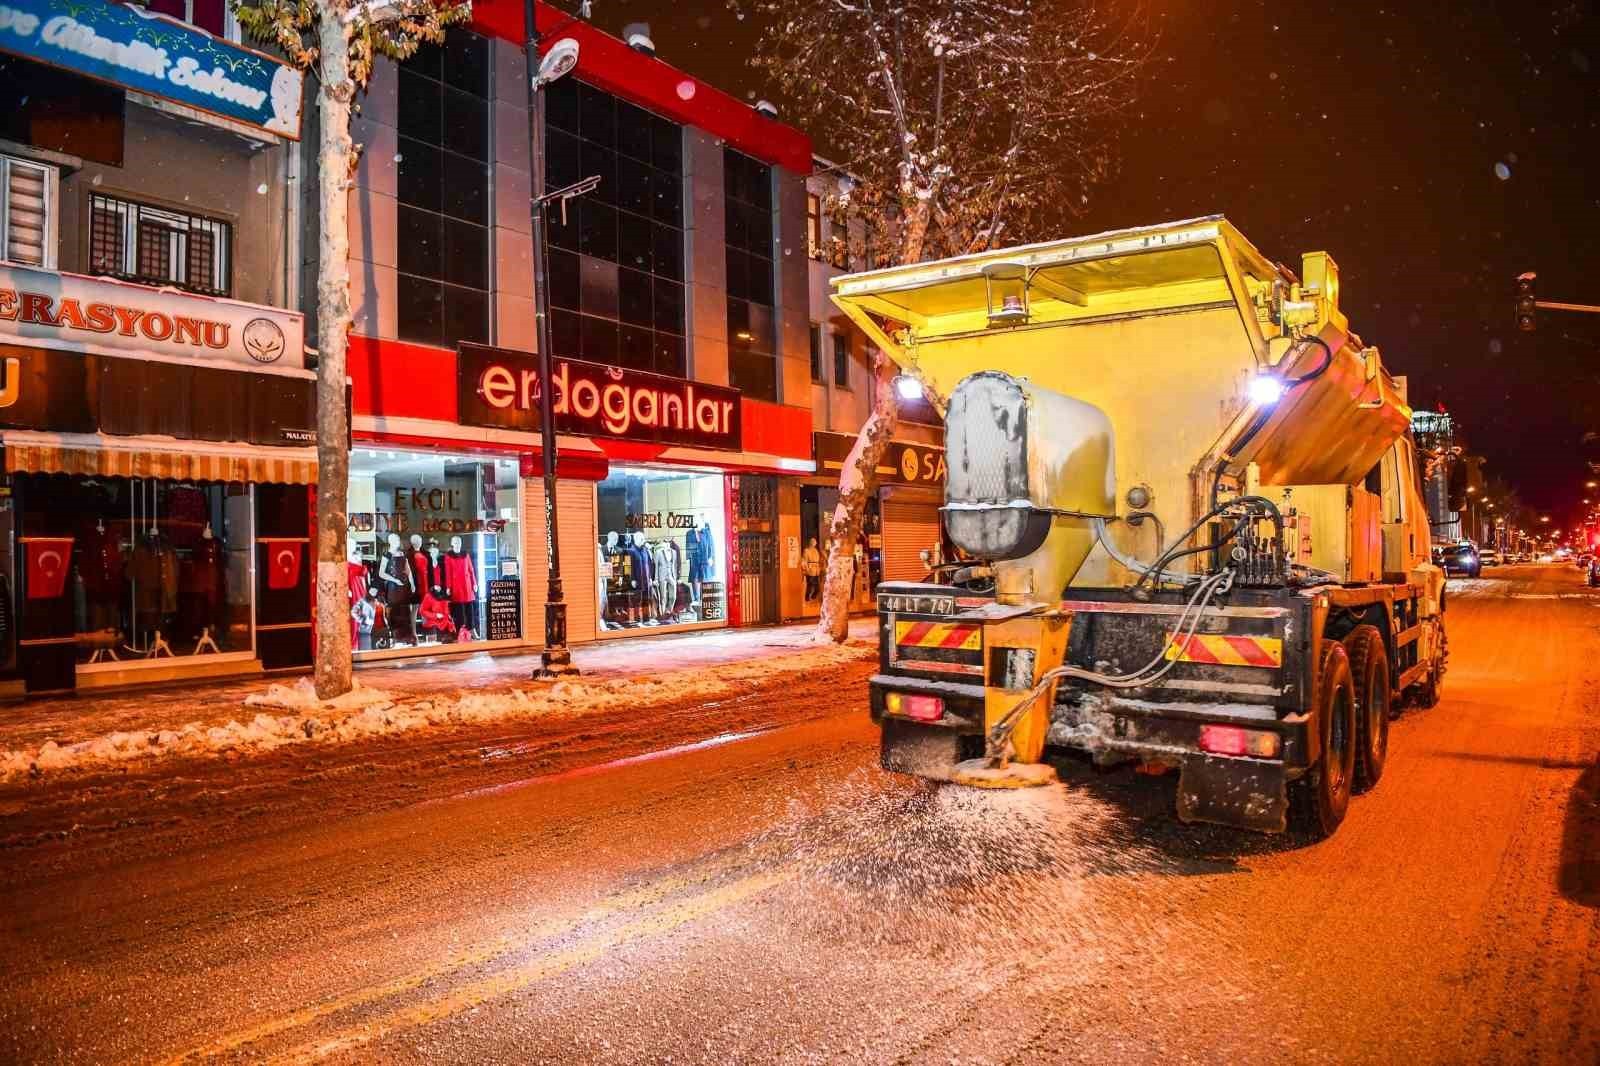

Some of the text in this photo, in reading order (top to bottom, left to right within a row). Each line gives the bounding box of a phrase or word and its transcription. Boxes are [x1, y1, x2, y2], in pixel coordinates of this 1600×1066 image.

[482, 362, 733, 434] erdoğanlar
[886, 597, 953, 614] 44 LT 747
